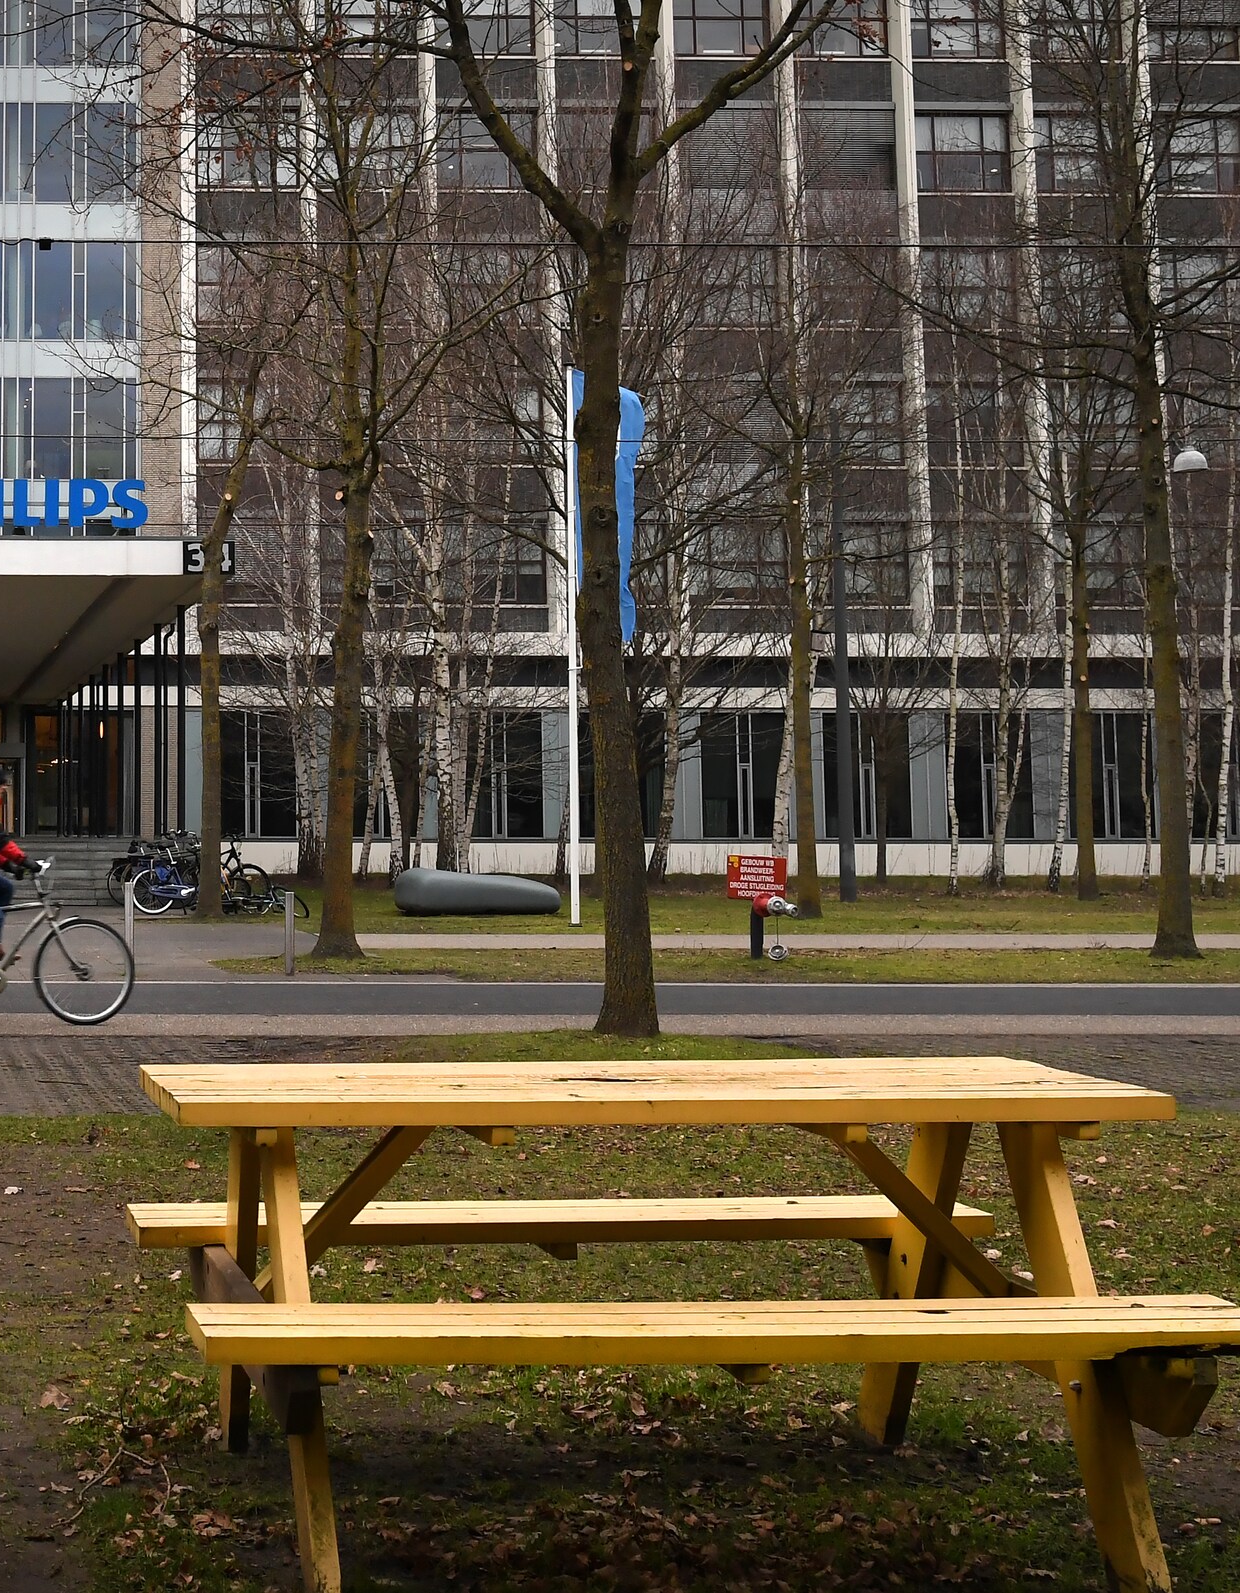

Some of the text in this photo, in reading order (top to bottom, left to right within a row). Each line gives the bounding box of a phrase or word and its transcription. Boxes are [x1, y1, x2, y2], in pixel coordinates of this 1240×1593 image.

[740, 866, 775, 874] BRANDWEER-
[740, 874, 774, 882] AANSLUITING
[729, 881, 748, 889] DROGE
